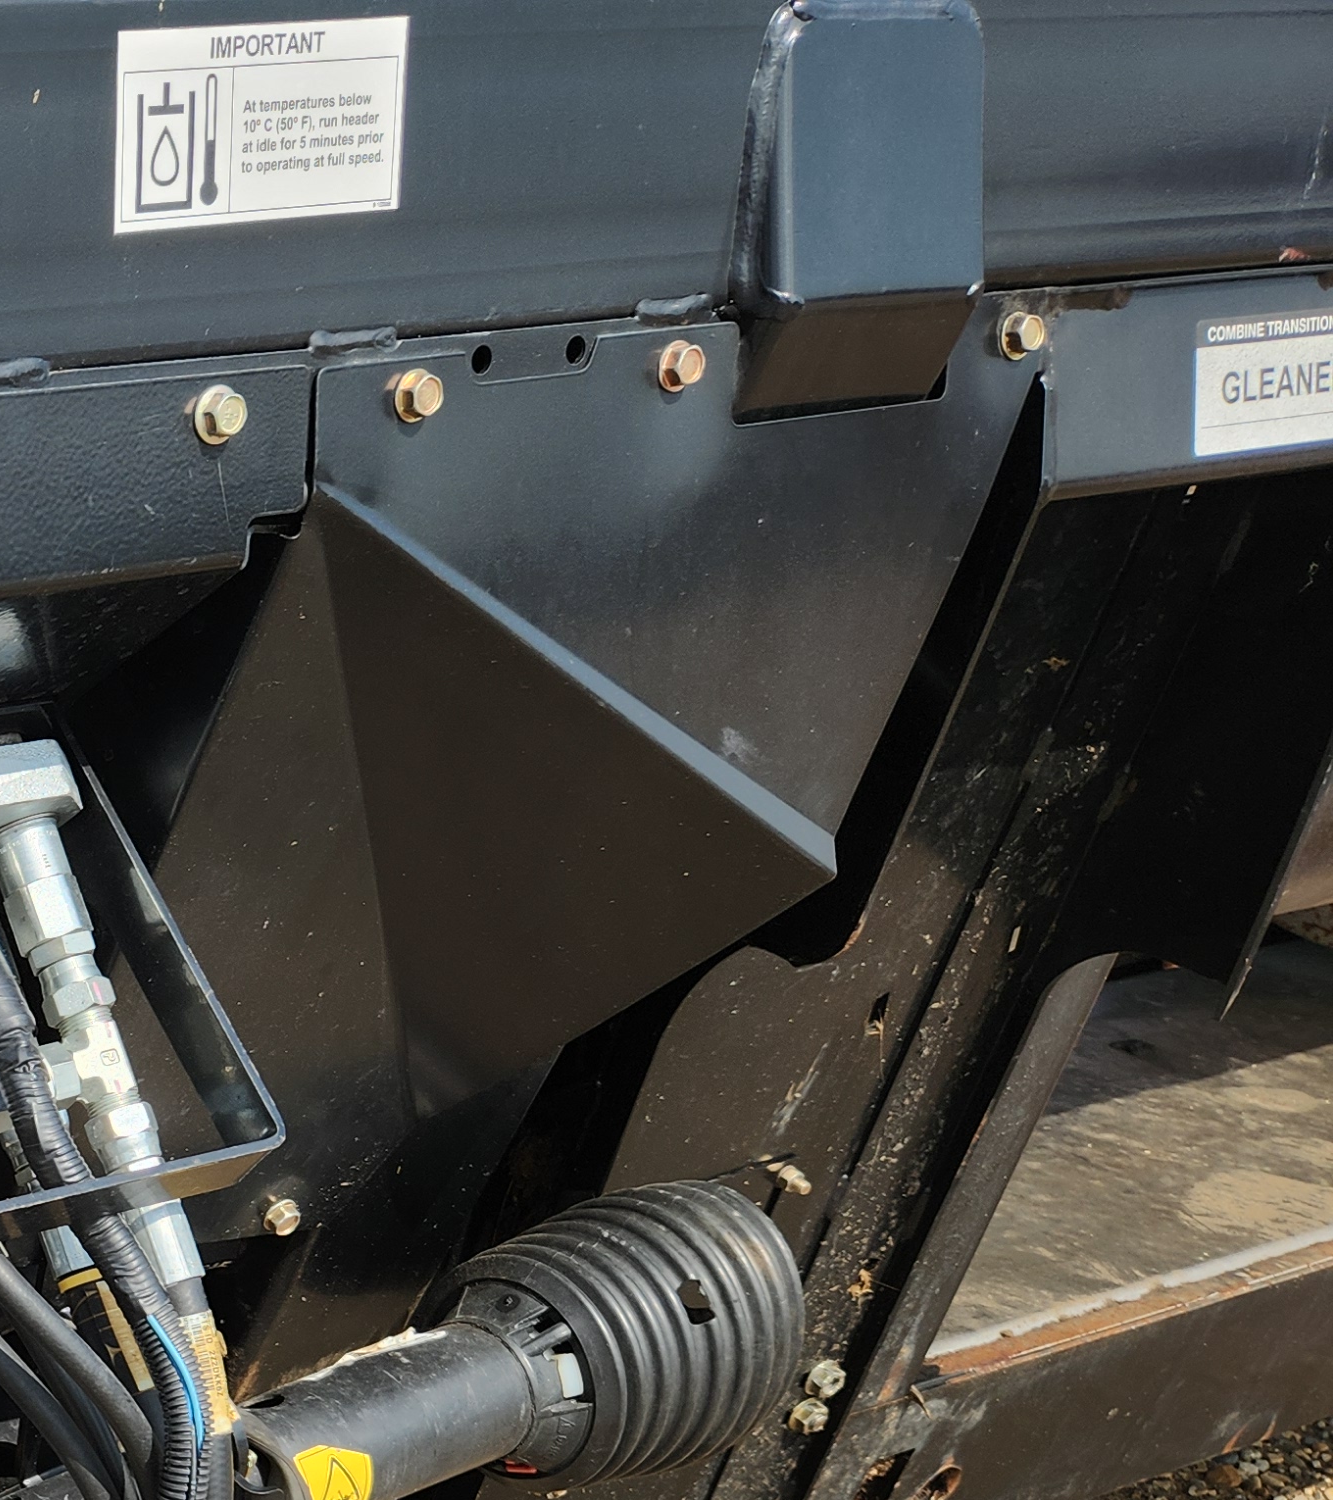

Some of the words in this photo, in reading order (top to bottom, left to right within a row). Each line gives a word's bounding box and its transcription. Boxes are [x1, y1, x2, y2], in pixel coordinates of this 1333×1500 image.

[210, 31, 326, 59] IMPORTANT
[242, 99, 256, 113] At
[259, 96, 335, 114] temperatures
[338, 92, 372, 106] below
[263, 117, 272, 132] C
[318, 116, 337, 127] run
[341, 111, 379, 126] header
[241, 140, 253, 153] at
[256, 137, 276, 152] idle
[279, 136, 297, 150] for
[299, 135, 306, 149] 5
[309, 133, 354, 148] minutes
[357, 130, 384, 147] prior
[241, 160, 252, 173] to
[255, 155, 310, 174] operating
[313, 154, 324, 167] at
[326, 151, 345, 166] full
[348, 149, 383, 167] speed.
[1207, 322, 1265, 342] COMBINE
[1221, 360, 1332, 405] GLEANE
